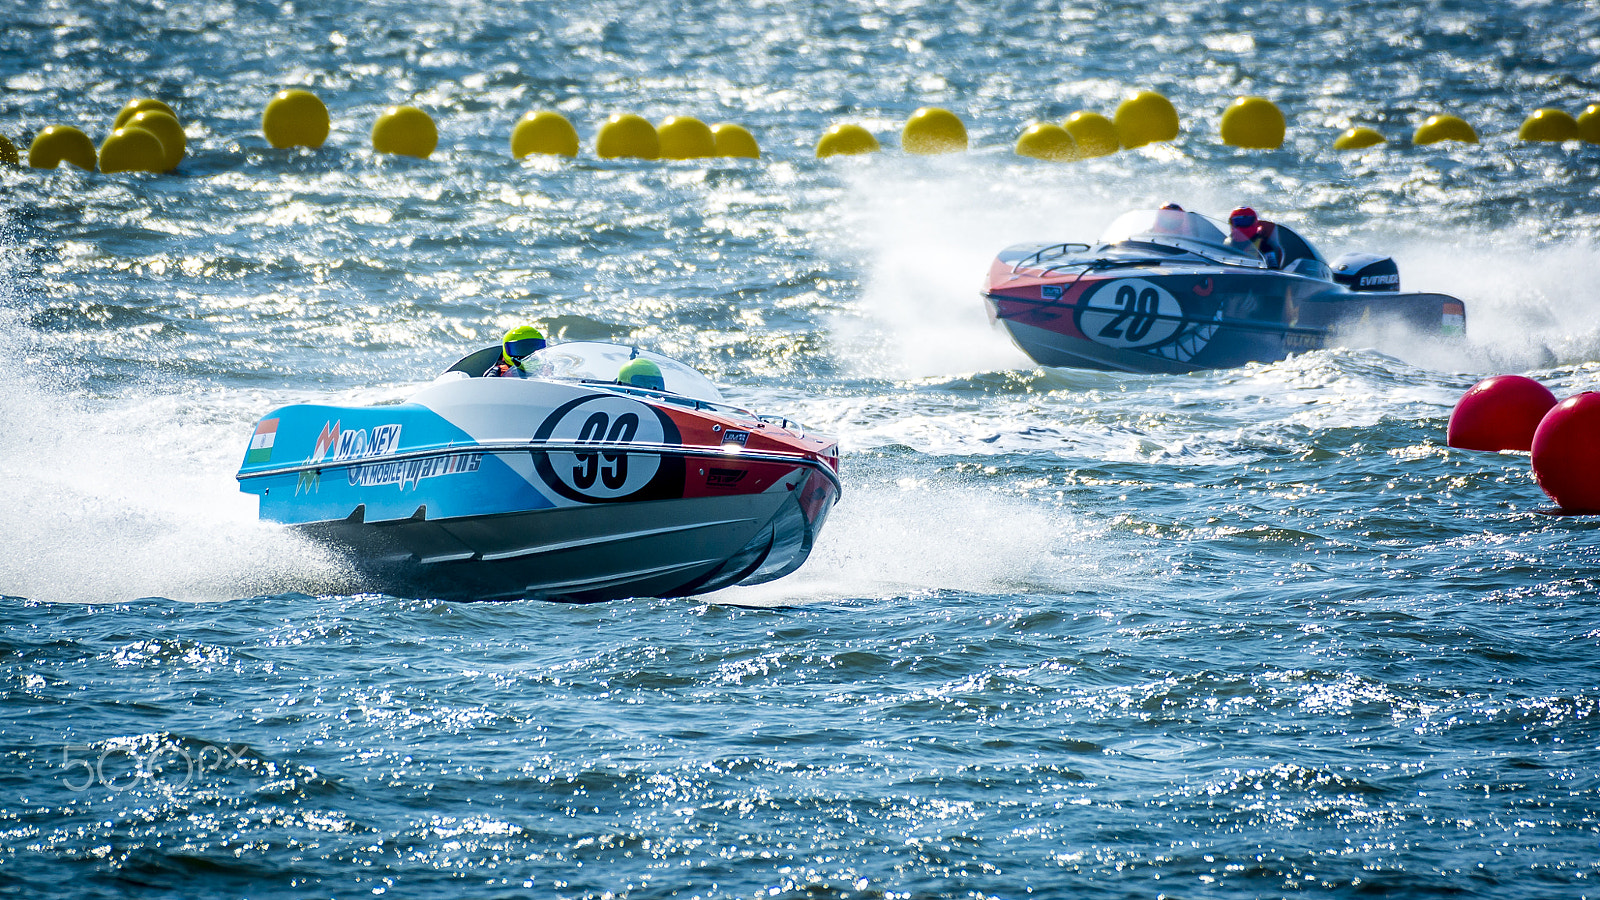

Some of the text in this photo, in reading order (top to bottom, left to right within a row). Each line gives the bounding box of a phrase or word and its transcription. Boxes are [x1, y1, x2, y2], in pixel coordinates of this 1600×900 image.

[1097, 285, 1160, 342] 20
[336, 425, 399, 460] MONEY
[572, 411, 639, 490] 99
